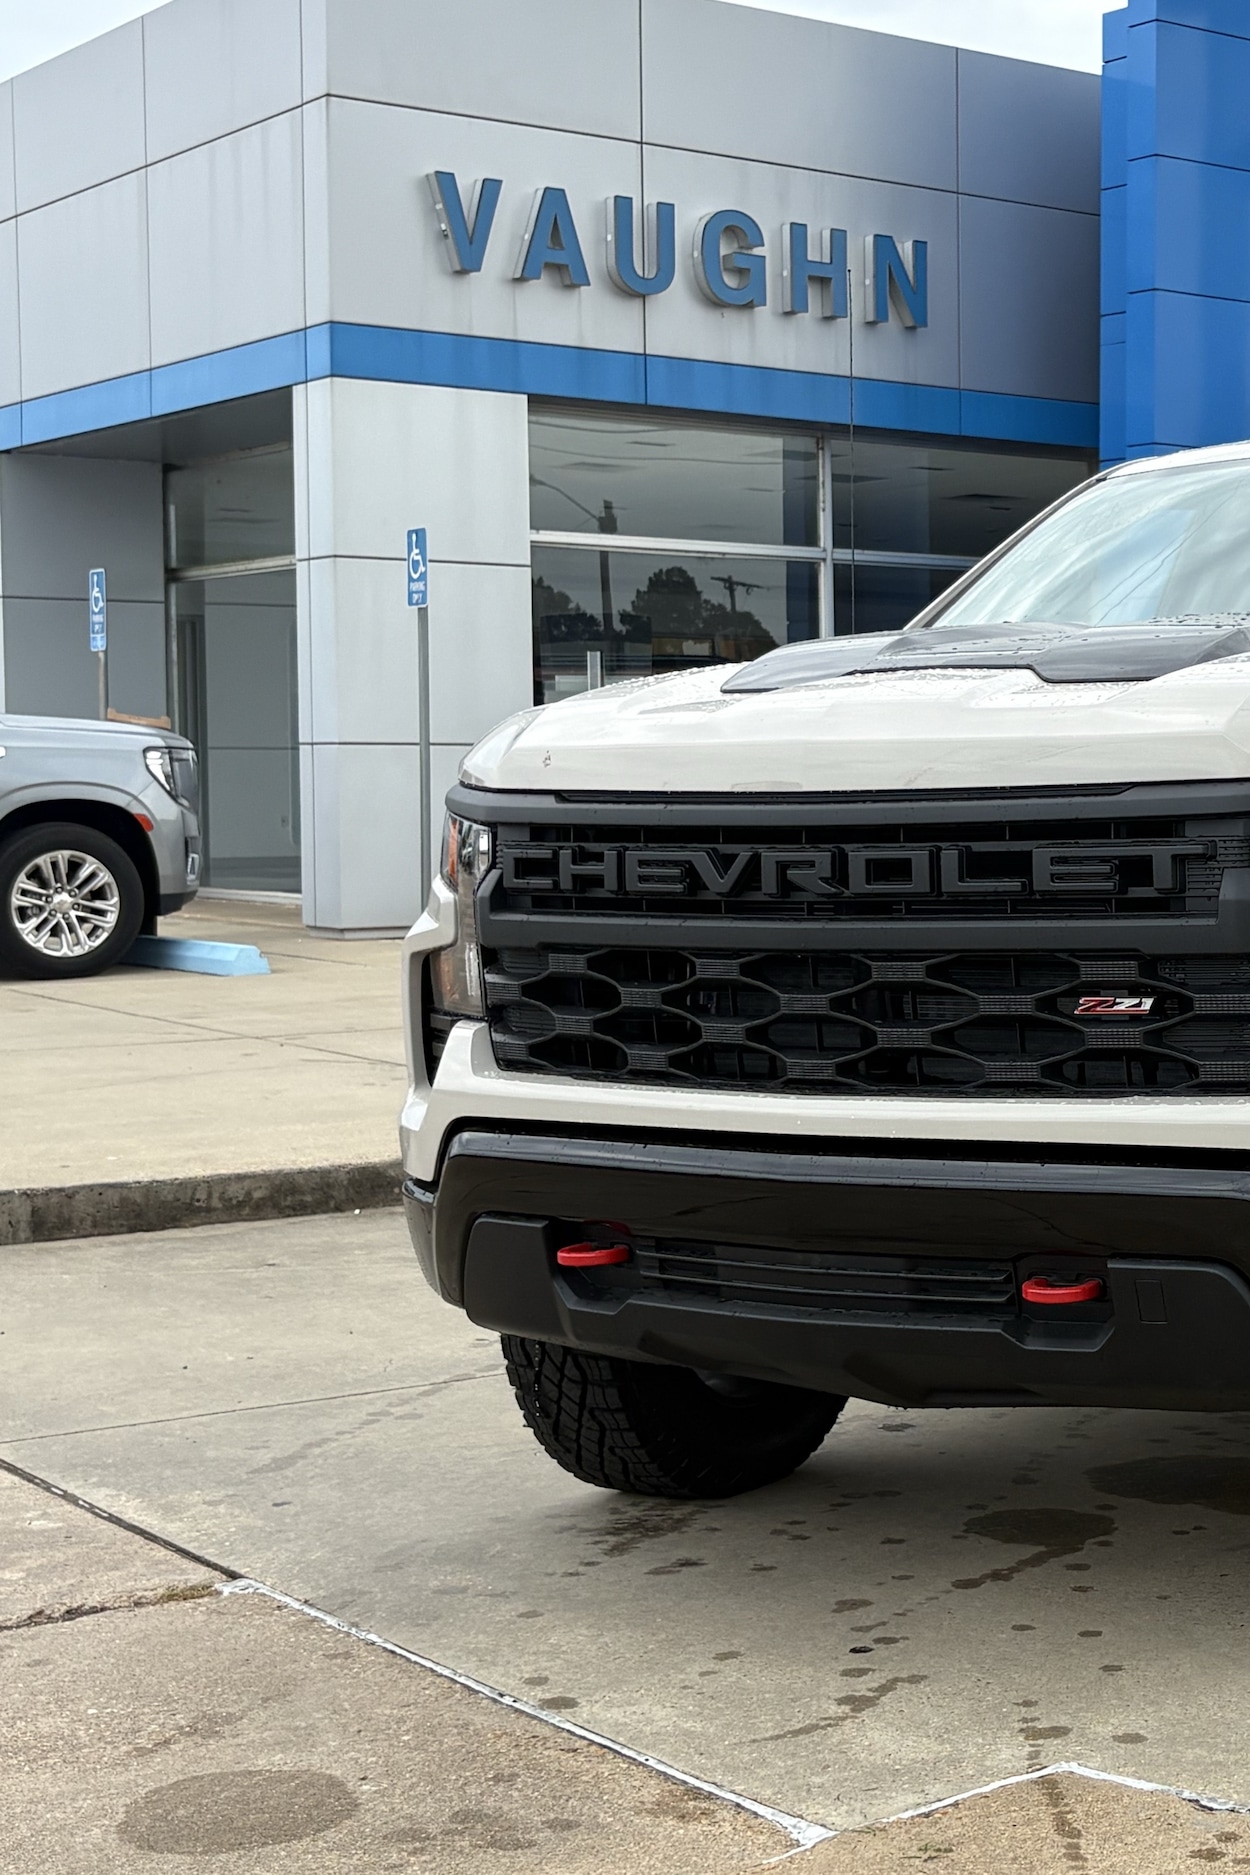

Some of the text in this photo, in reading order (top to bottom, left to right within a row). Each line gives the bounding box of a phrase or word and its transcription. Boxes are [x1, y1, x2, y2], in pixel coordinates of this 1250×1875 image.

[428, 170, 928, 328] VAUGHN
[502, 841, 1216, 896] CHEVROLET
[1074, 997, 1154, 1015] Z71
